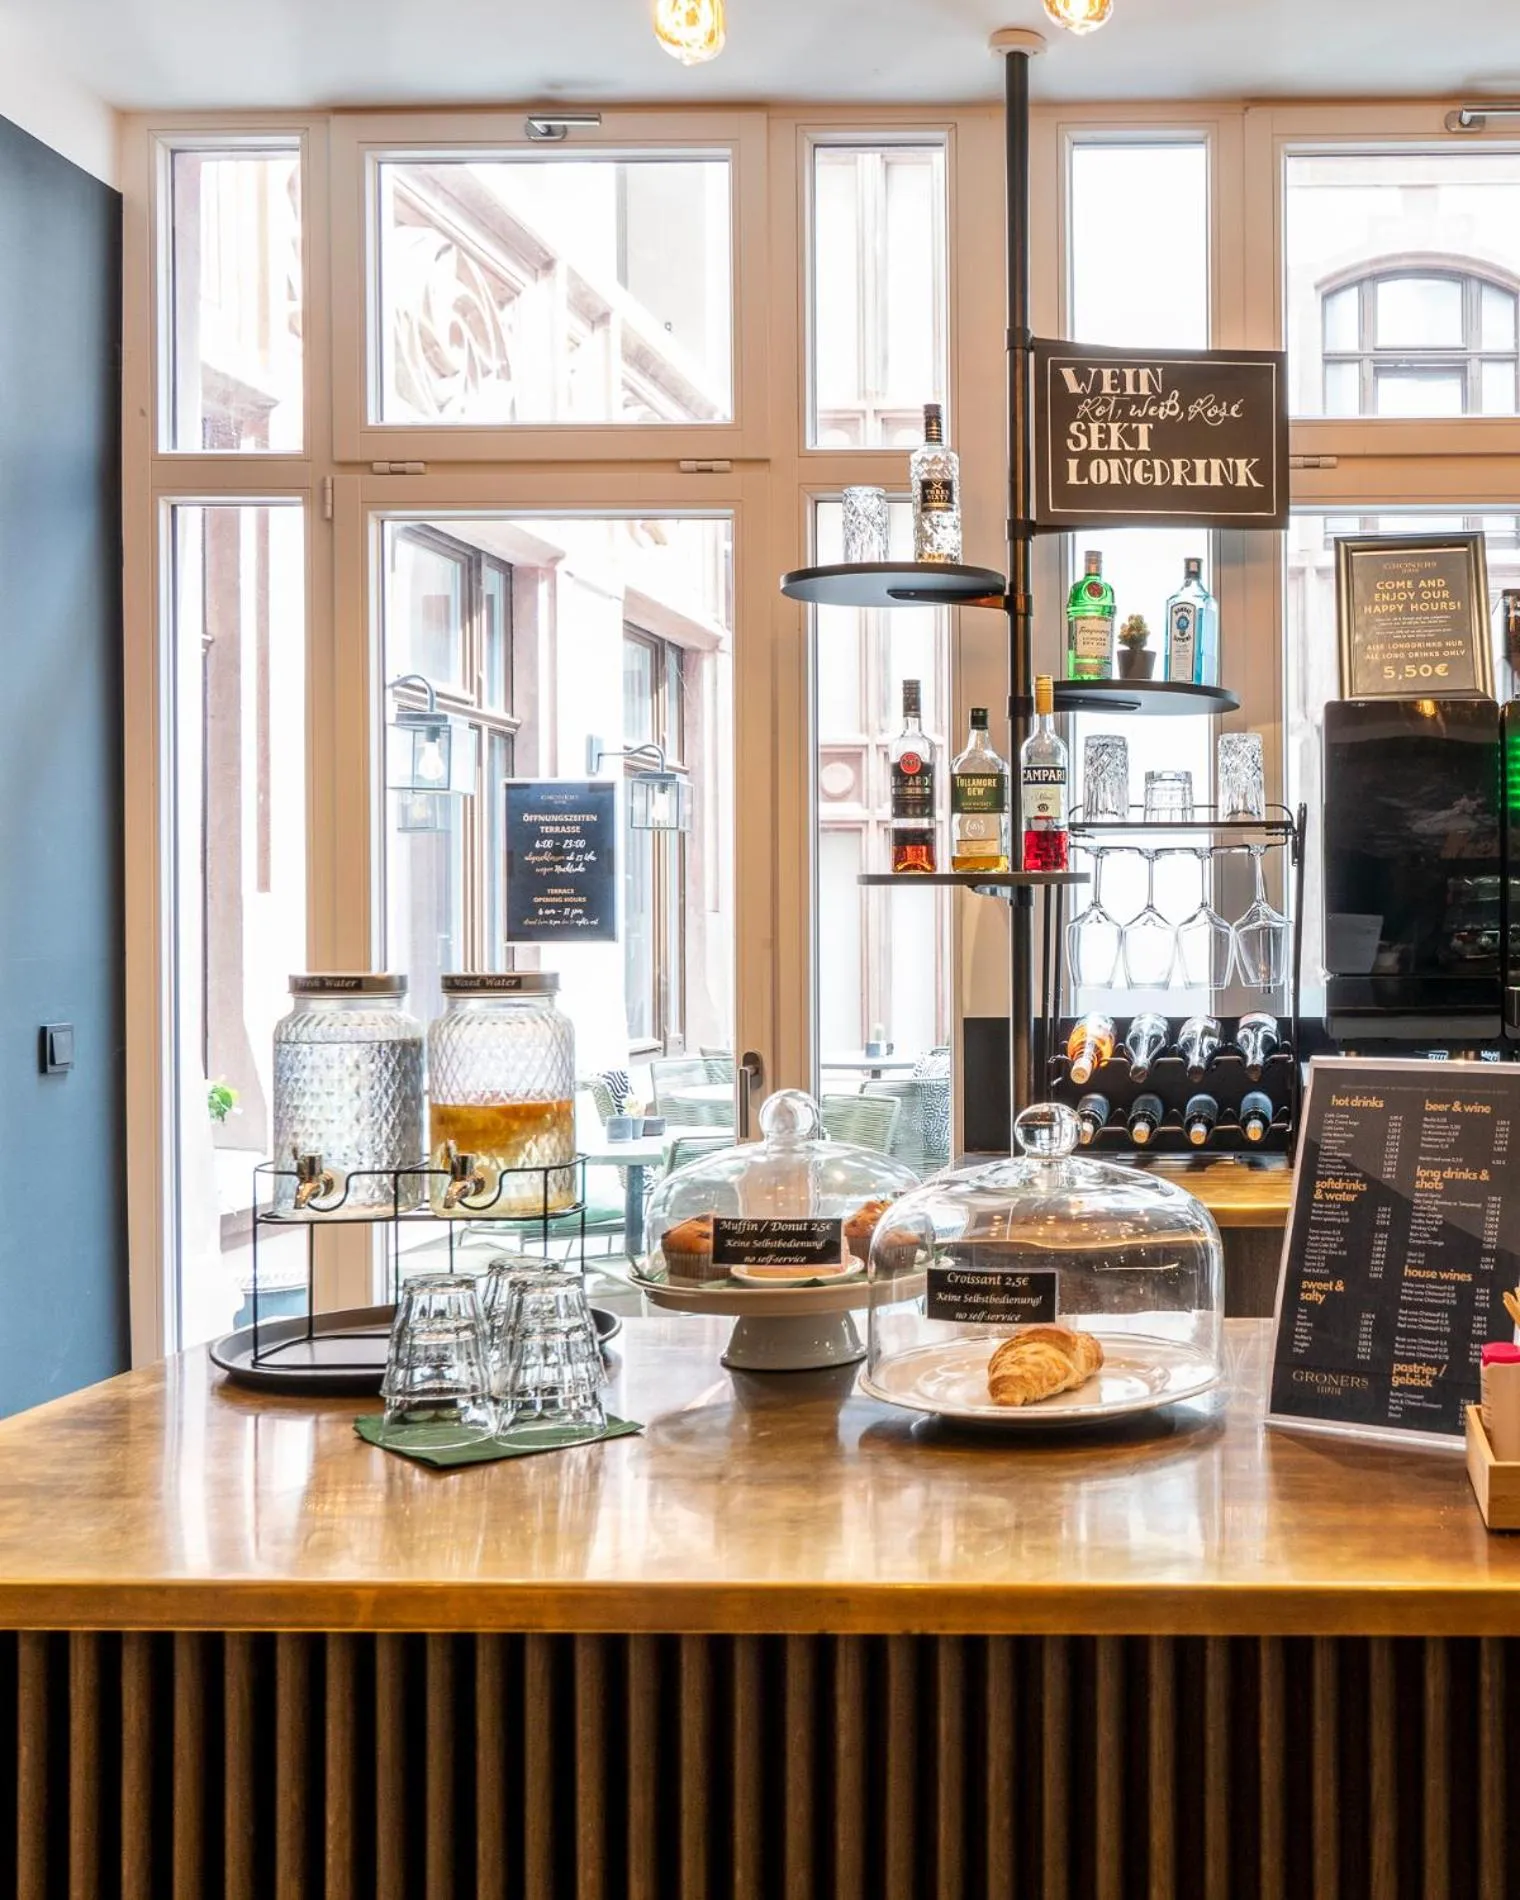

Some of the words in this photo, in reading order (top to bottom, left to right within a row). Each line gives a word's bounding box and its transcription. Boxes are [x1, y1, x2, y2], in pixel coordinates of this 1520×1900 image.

[1059, 367, 1163, 395] WEIN
[1066, 421, 1153, 451] SEKT
[1066, 458, 1264, 487] LONGDRINK
[1376, 580, 1413, 590] COME
[1418, 578, 1446, 589] AND
[1374, 592, 1416, 602] ENJOY
[1421, 590, 1450, 600] OUR
[1363, 604, 1404, 614] HAPPY
[1410, 602, 1462, 612] HOURS!
[1383, 664, 1449, 680] 5,50€
[955, 776, 998, 788] TULLAMORE
[1023, 770, 1065, 781] CAMPARI
[522, 812, 598, 822] ÖFFNUNGSZEITEN
[539, 825, 581, 834] TERRASSE
[324, 978, 359, 988] Water
[485, 976, 518, 987] Water
[1332, 1095, 1350, 1107] hot
[1350, 1096, 1384, 1110] drinks
[1424, 1100, 1449, 1112] beer
[1452, 1101, 1462, 1112] &
[1464, 1103, 1492, 1114] wine
[1416, 1167, 1441, 1182] long
[1442, 1168, 1478, 1181] drinks
[1479, 1170, 1490, 1181] &
[1315, 1178, 1368, 1192] softdrinks
[1415, 1179, 1444, 1191] shots
[1314, 1189, 1324, 1200] &
[1325, 1192, 1359, 1202] water
[720, 1220, 758, 1234] Muffin
[760, 1220, 769, 1232] /
[770, 1221, 808, 1232] Donut
[810, 1222, 832, 1233] 2,5€
[724, 1239, 750, 1248] Keine
[946, 1271, 1004, 1286] Croissant
[1004, 1276, 1030, 1288] 2,5€
[1404, 1266, 1437, 1280] house
[1440, 1269, 1473, 1282] wines
[1301, 1280, 1334, 1292] sweet
[1334, 1280, 1345, 1292] &
[936, 1291, 962, 1302] Keine
[964, 1293, 1044, 1308] Selbstbedienung!
[1300, 1290, 1326, 1305] salty
[1392, 1362, 1438, 1378] pastries
[1292, 1370, 1369, 1389] GRONERS
[1391, 1373, 1434, 1388] gebäck
